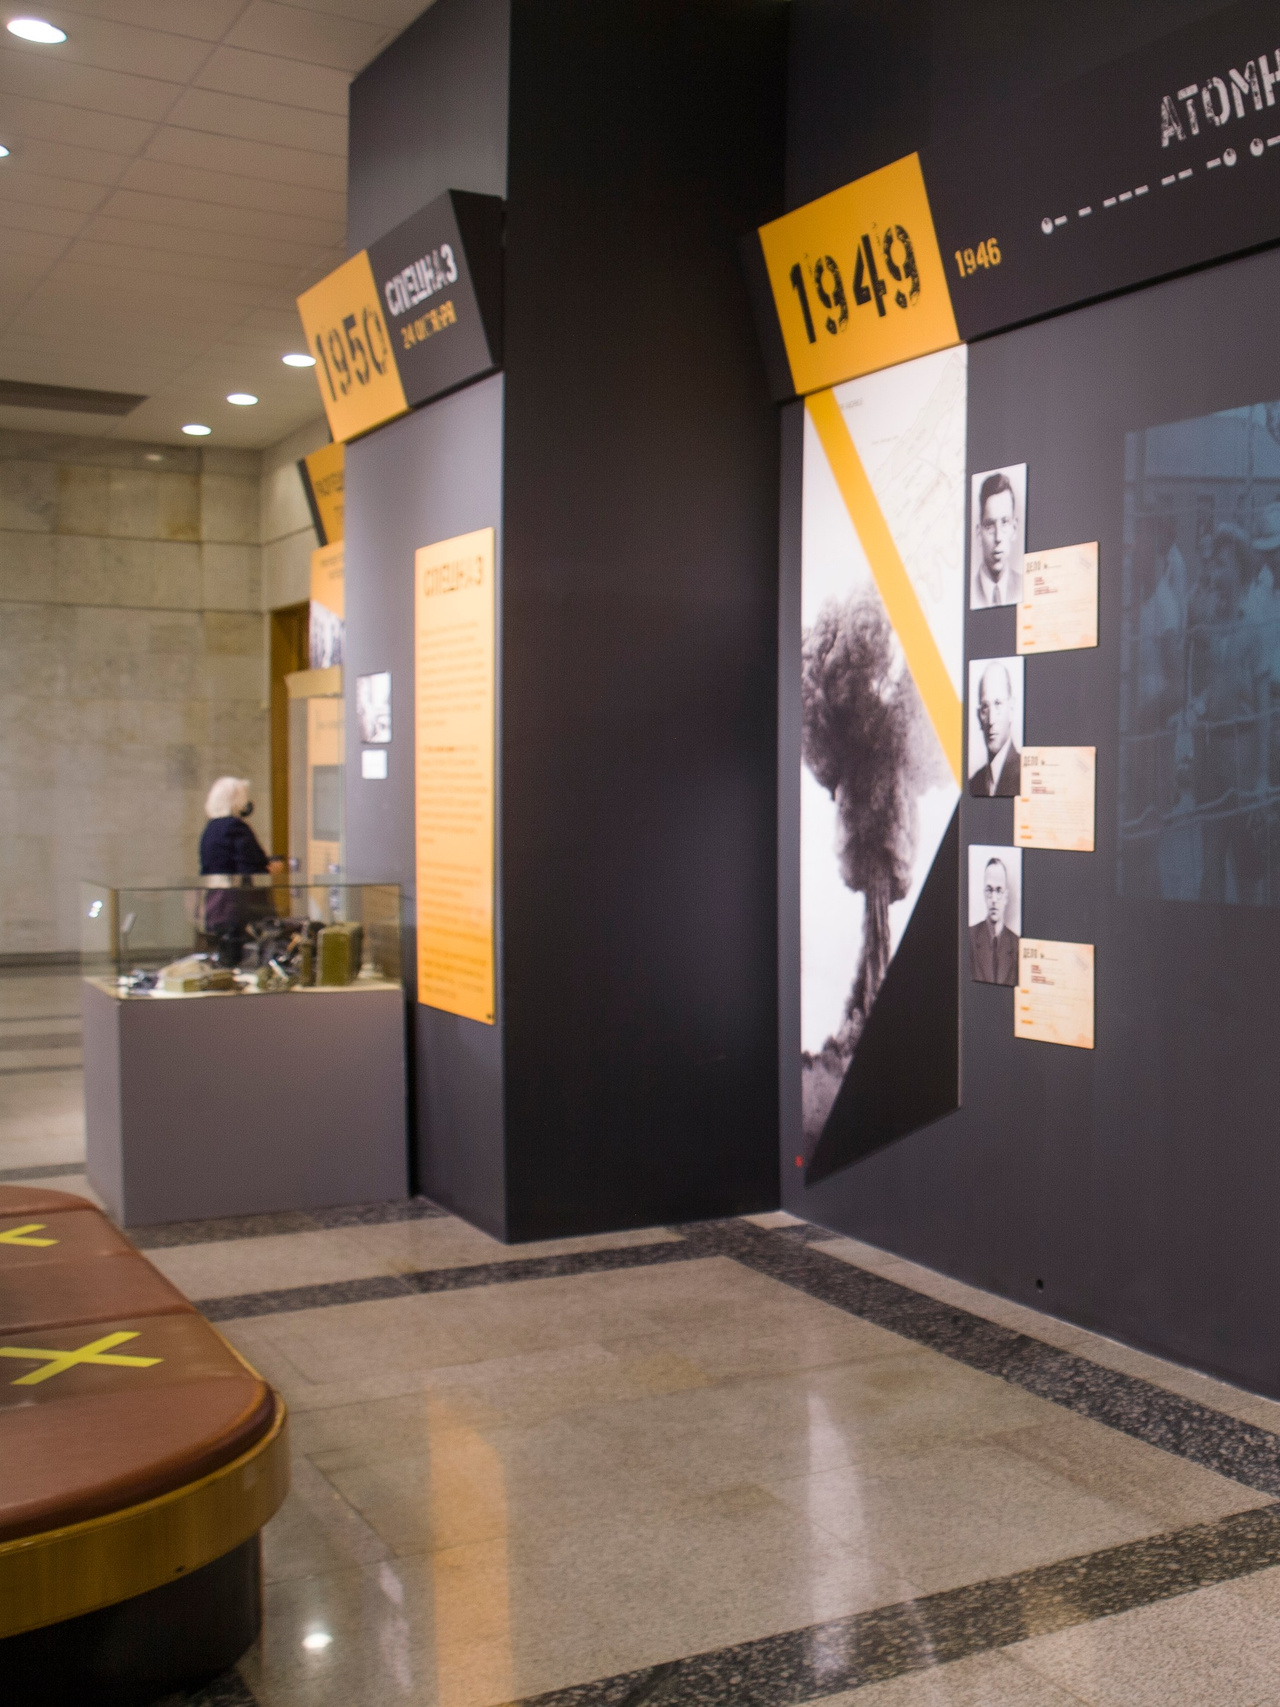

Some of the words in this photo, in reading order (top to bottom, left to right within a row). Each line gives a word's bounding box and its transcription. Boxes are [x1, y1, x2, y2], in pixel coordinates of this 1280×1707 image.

[384, 243, 459, 317] СПЕЦНАЗ
[789, 222, 922, 345] 1949
[955, 237, 1002, 278] 1946
[313, 303, 389, 403] 1950
